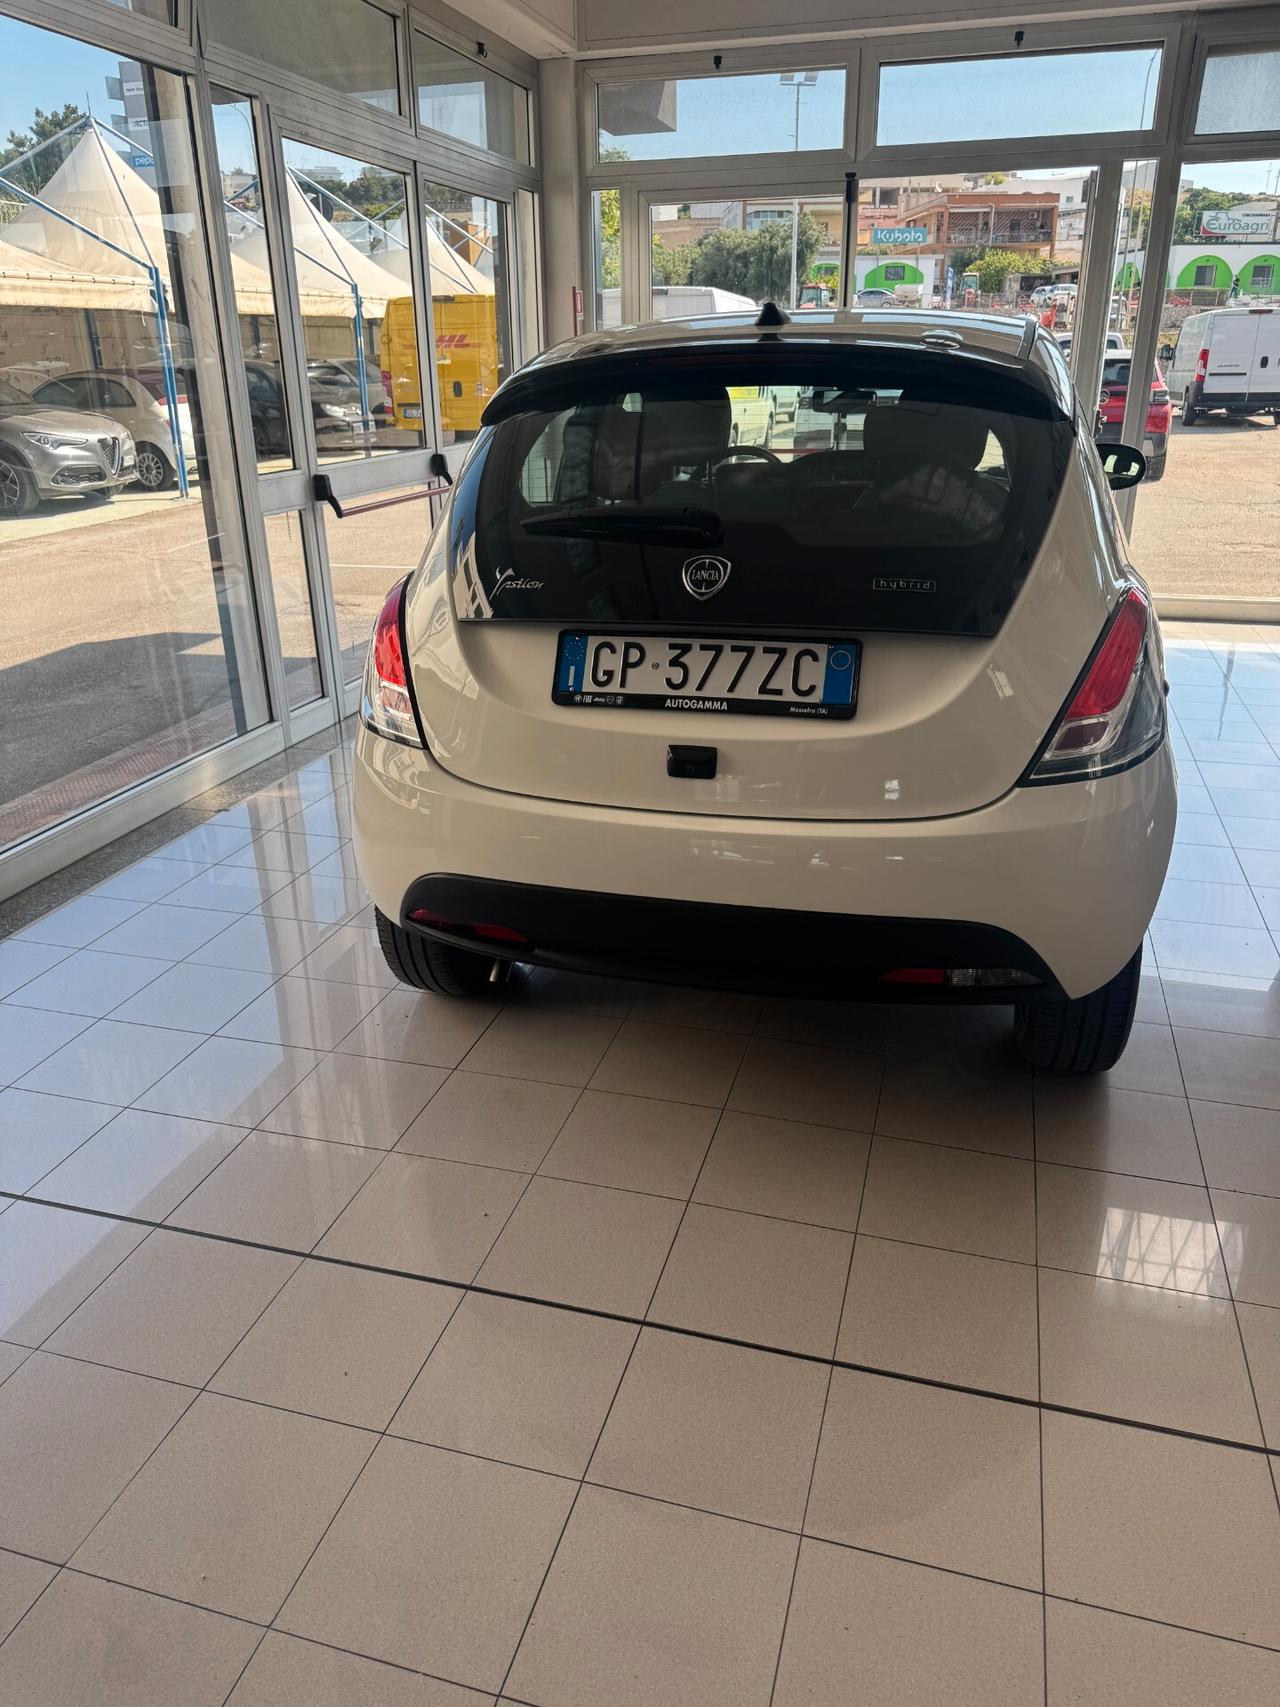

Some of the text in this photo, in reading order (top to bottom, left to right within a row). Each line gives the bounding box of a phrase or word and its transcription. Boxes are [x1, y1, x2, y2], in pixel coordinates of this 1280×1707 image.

[1206, 217, 1269, 233] Euroagri
[877, 229, 924, 242] Kubota
[691, 569, 719, 580] LANCIA
[489, 566, 545, 600] Ypsilon
[880, 579, 930, 589] hybrid
[590, 641, 646, 689] GP
[663, 642, 820, 698] 377ZC
[664, 698, 728, 711] AUTOGAMMA
